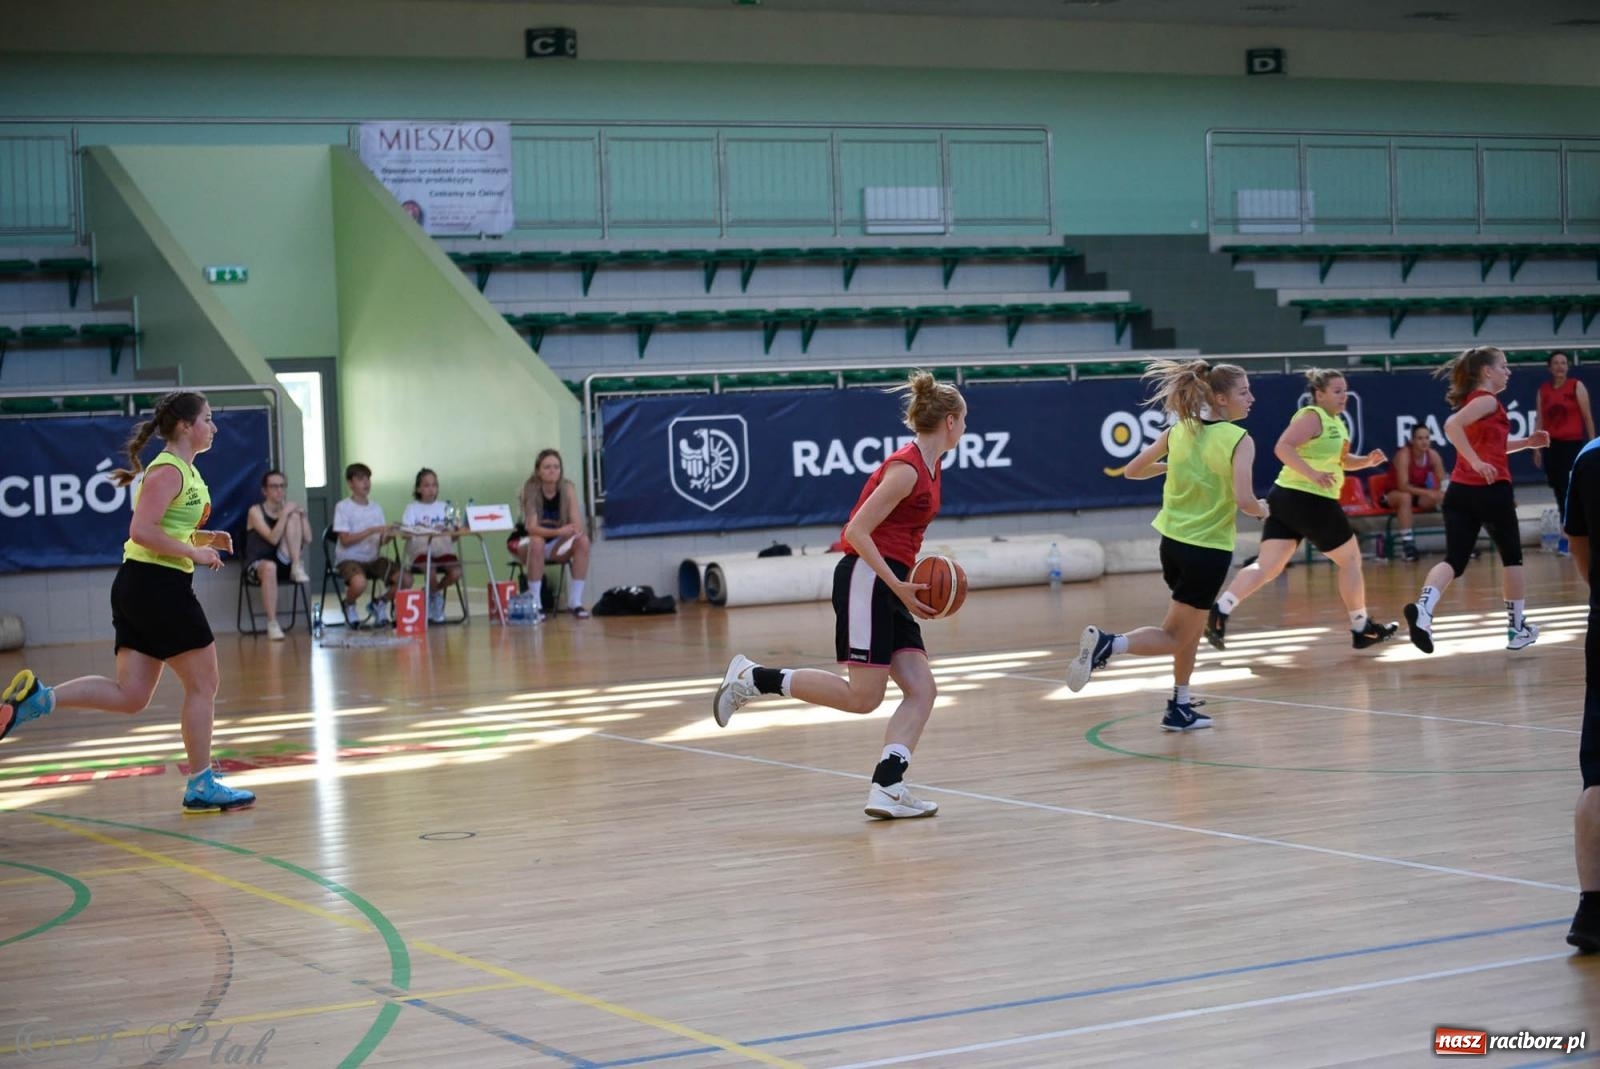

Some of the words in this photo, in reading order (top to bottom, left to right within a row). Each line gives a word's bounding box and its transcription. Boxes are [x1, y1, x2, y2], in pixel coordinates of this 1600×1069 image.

[532, 37, 555, 55] C
[1253, 57, 1276, 73] D
[379, 128, 495, 151] MIESZKO
[792, 432, 1012, 477] RACIRZ
[402, 594, 420, 624] 5
